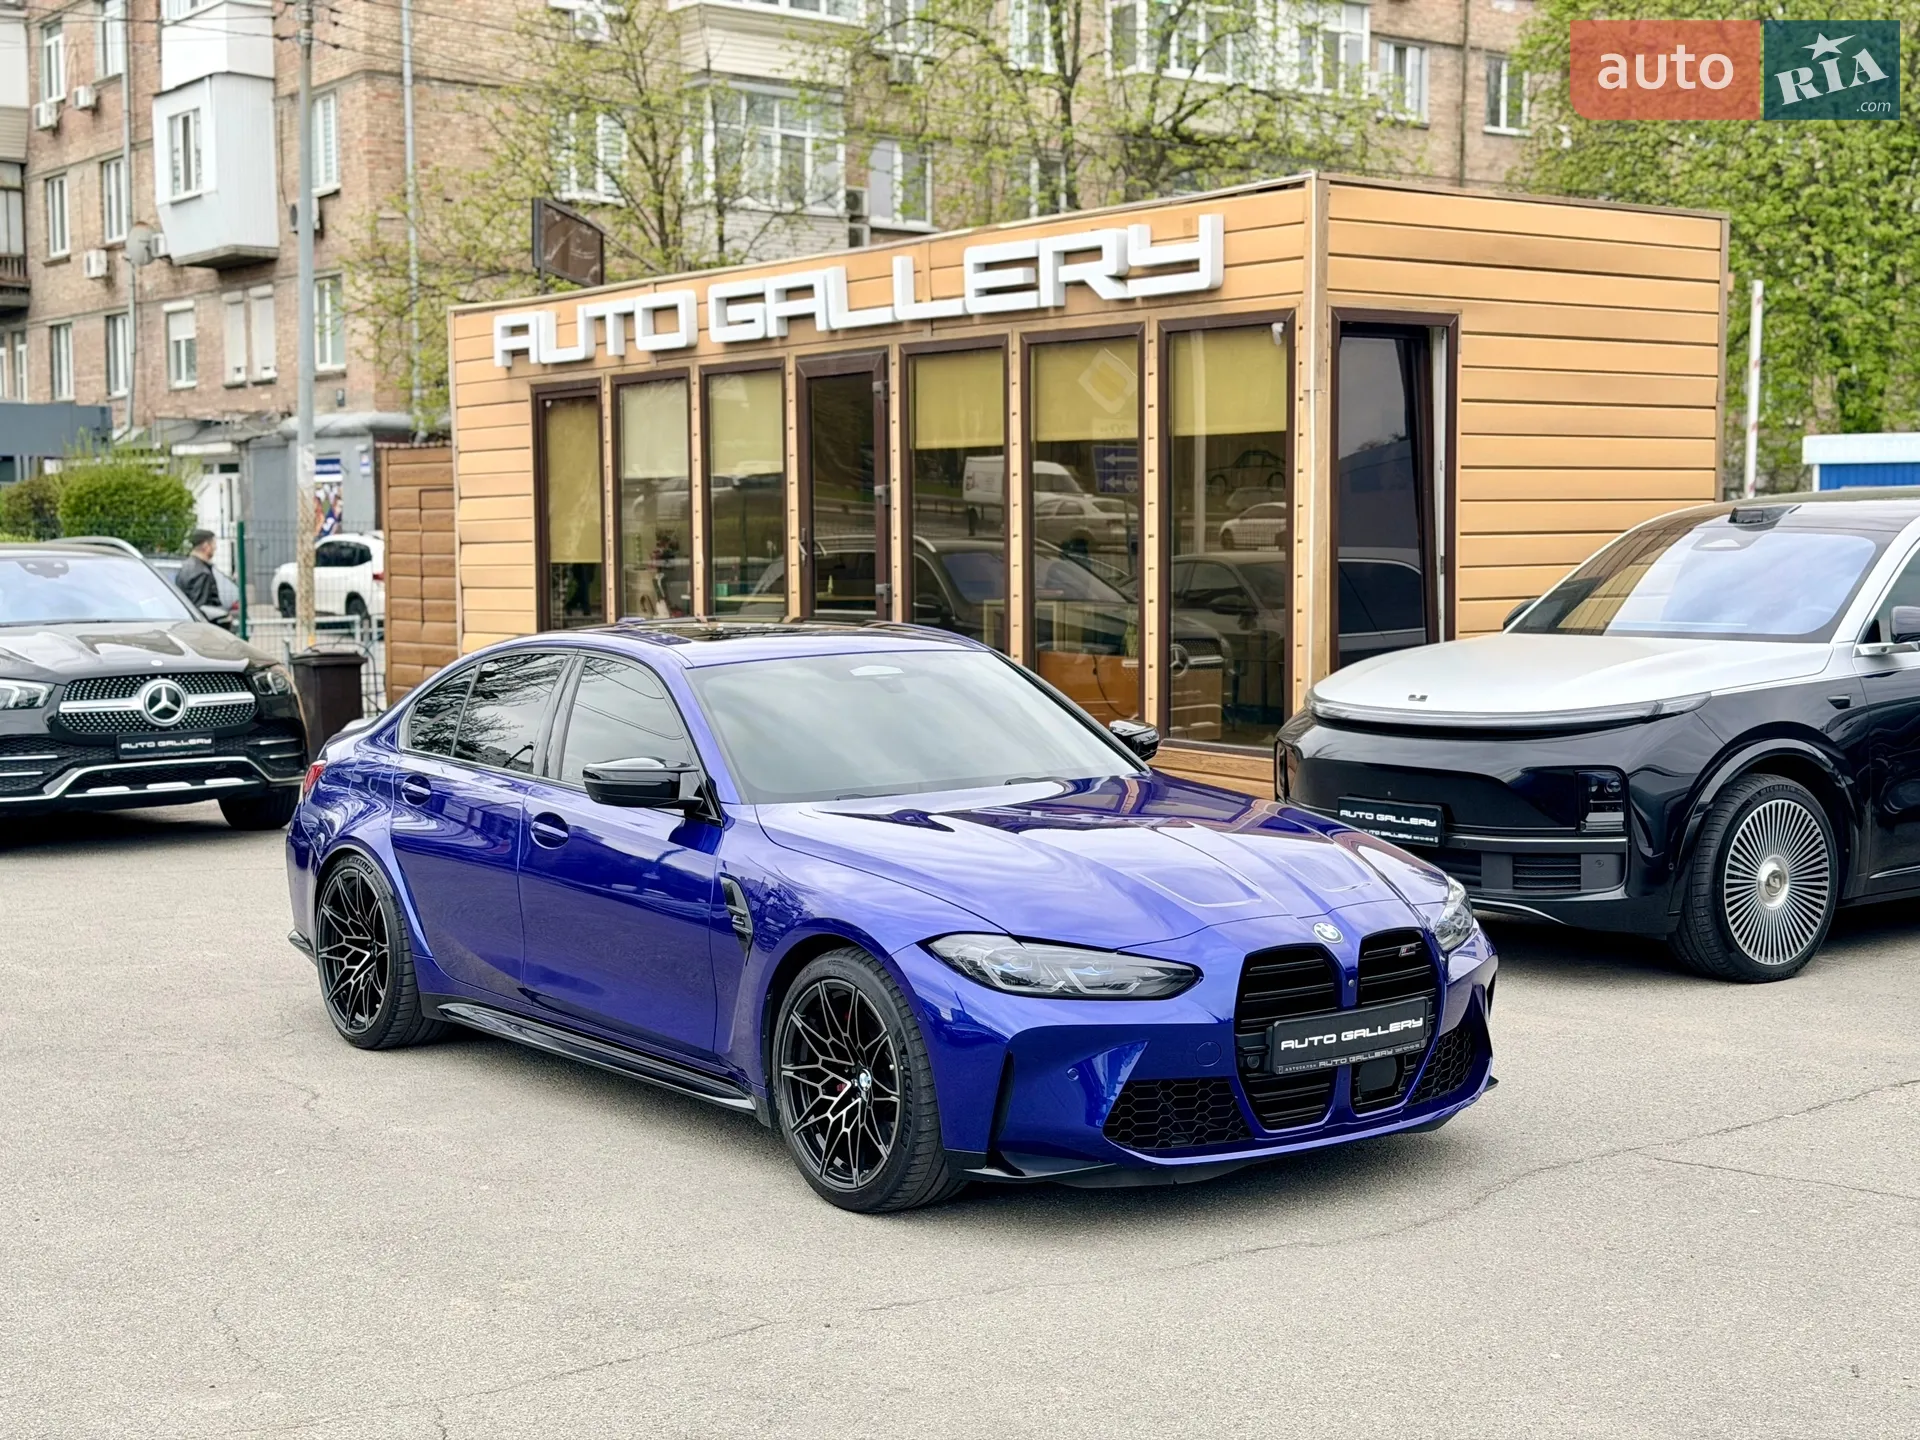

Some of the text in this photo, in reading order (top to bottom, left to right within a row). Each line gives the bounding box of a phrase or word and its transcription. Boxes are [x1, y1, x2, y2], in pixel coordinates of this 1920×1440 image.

[493, 214, 1225, 368] AUTO GALLERY
[120, 737, 212, 749] AUTO GALLERY
[1339, 809, 1437, 827] AUTO GALLERY
[1280, 1017, 1423, 1051] AUTO GALLERY
[1318, 1057, 1347, 1068] AUTO
[1349, 1048, 1393, 1062] GALLERY
